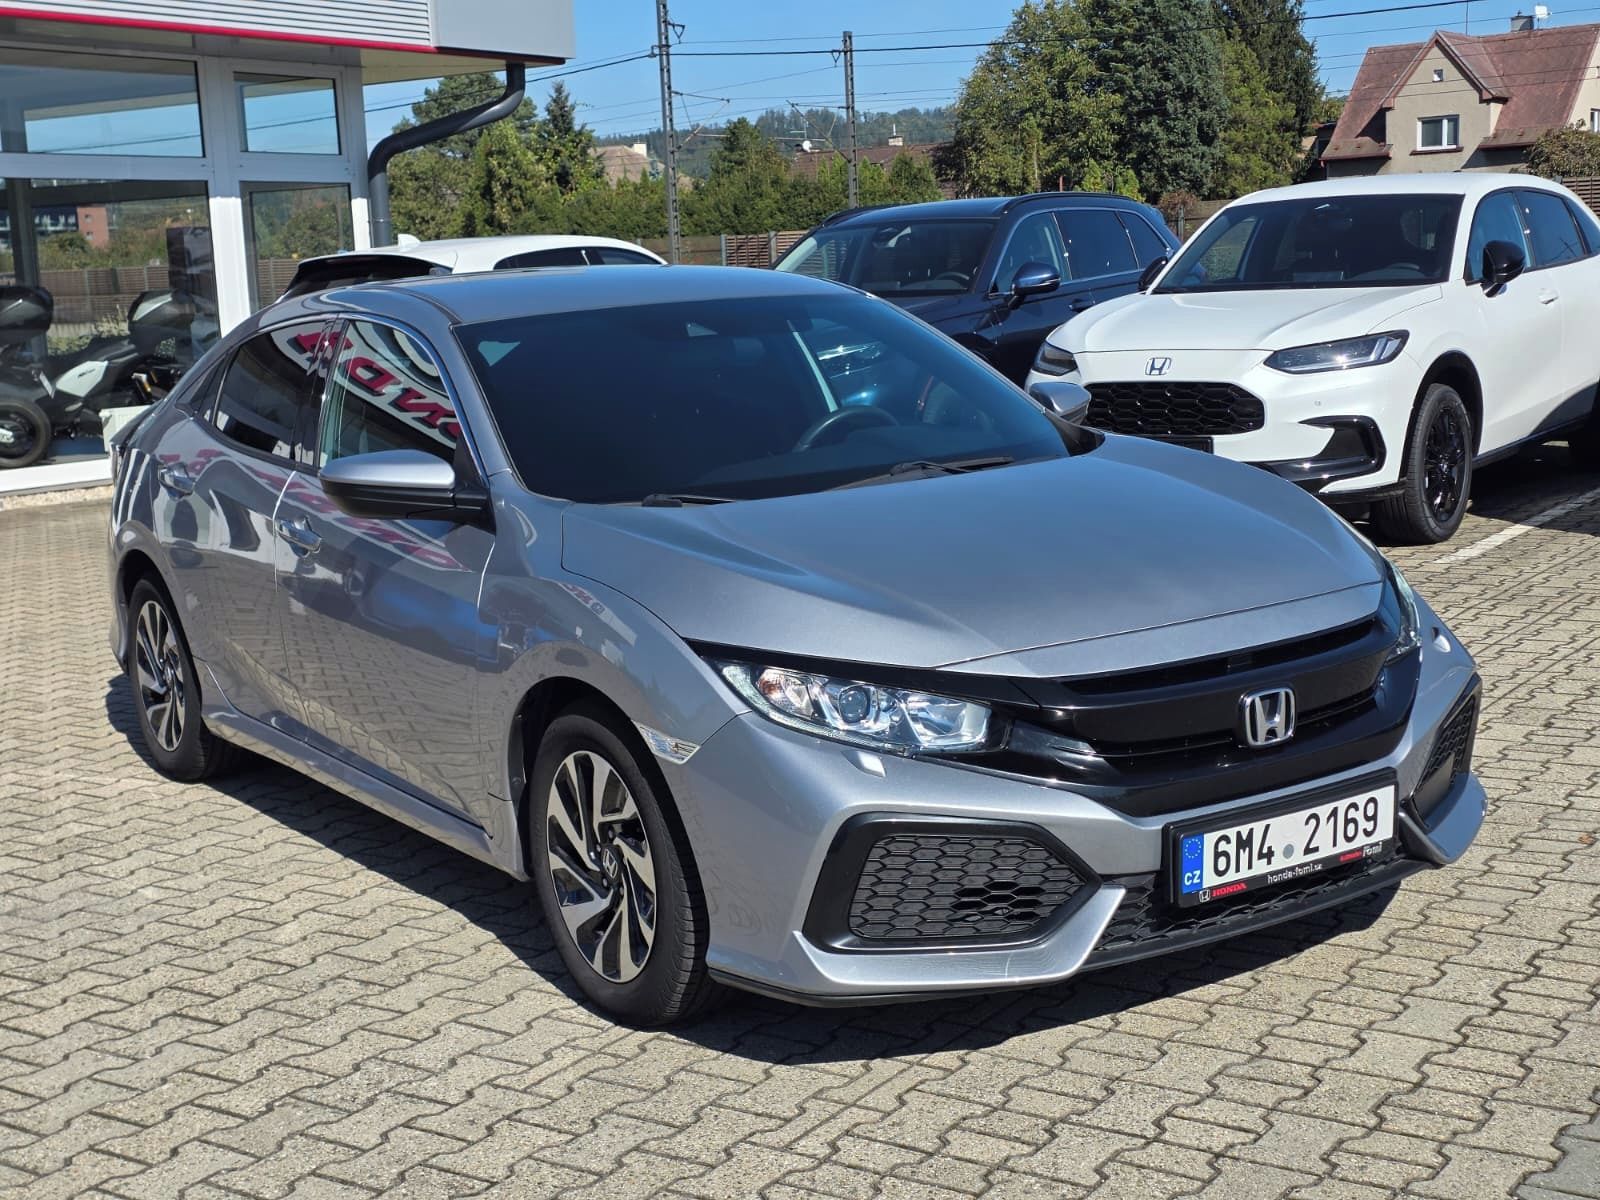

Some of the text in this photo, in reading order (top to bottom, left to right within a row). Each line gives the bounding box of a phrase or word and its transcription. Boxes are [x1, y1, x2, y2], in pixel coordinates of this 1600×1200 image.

[1212, 796, 1379, 878] 6M4 2169
[1183, 869, 1201, 886] CZ
[1211, 882, 1248, 897] HONDA
